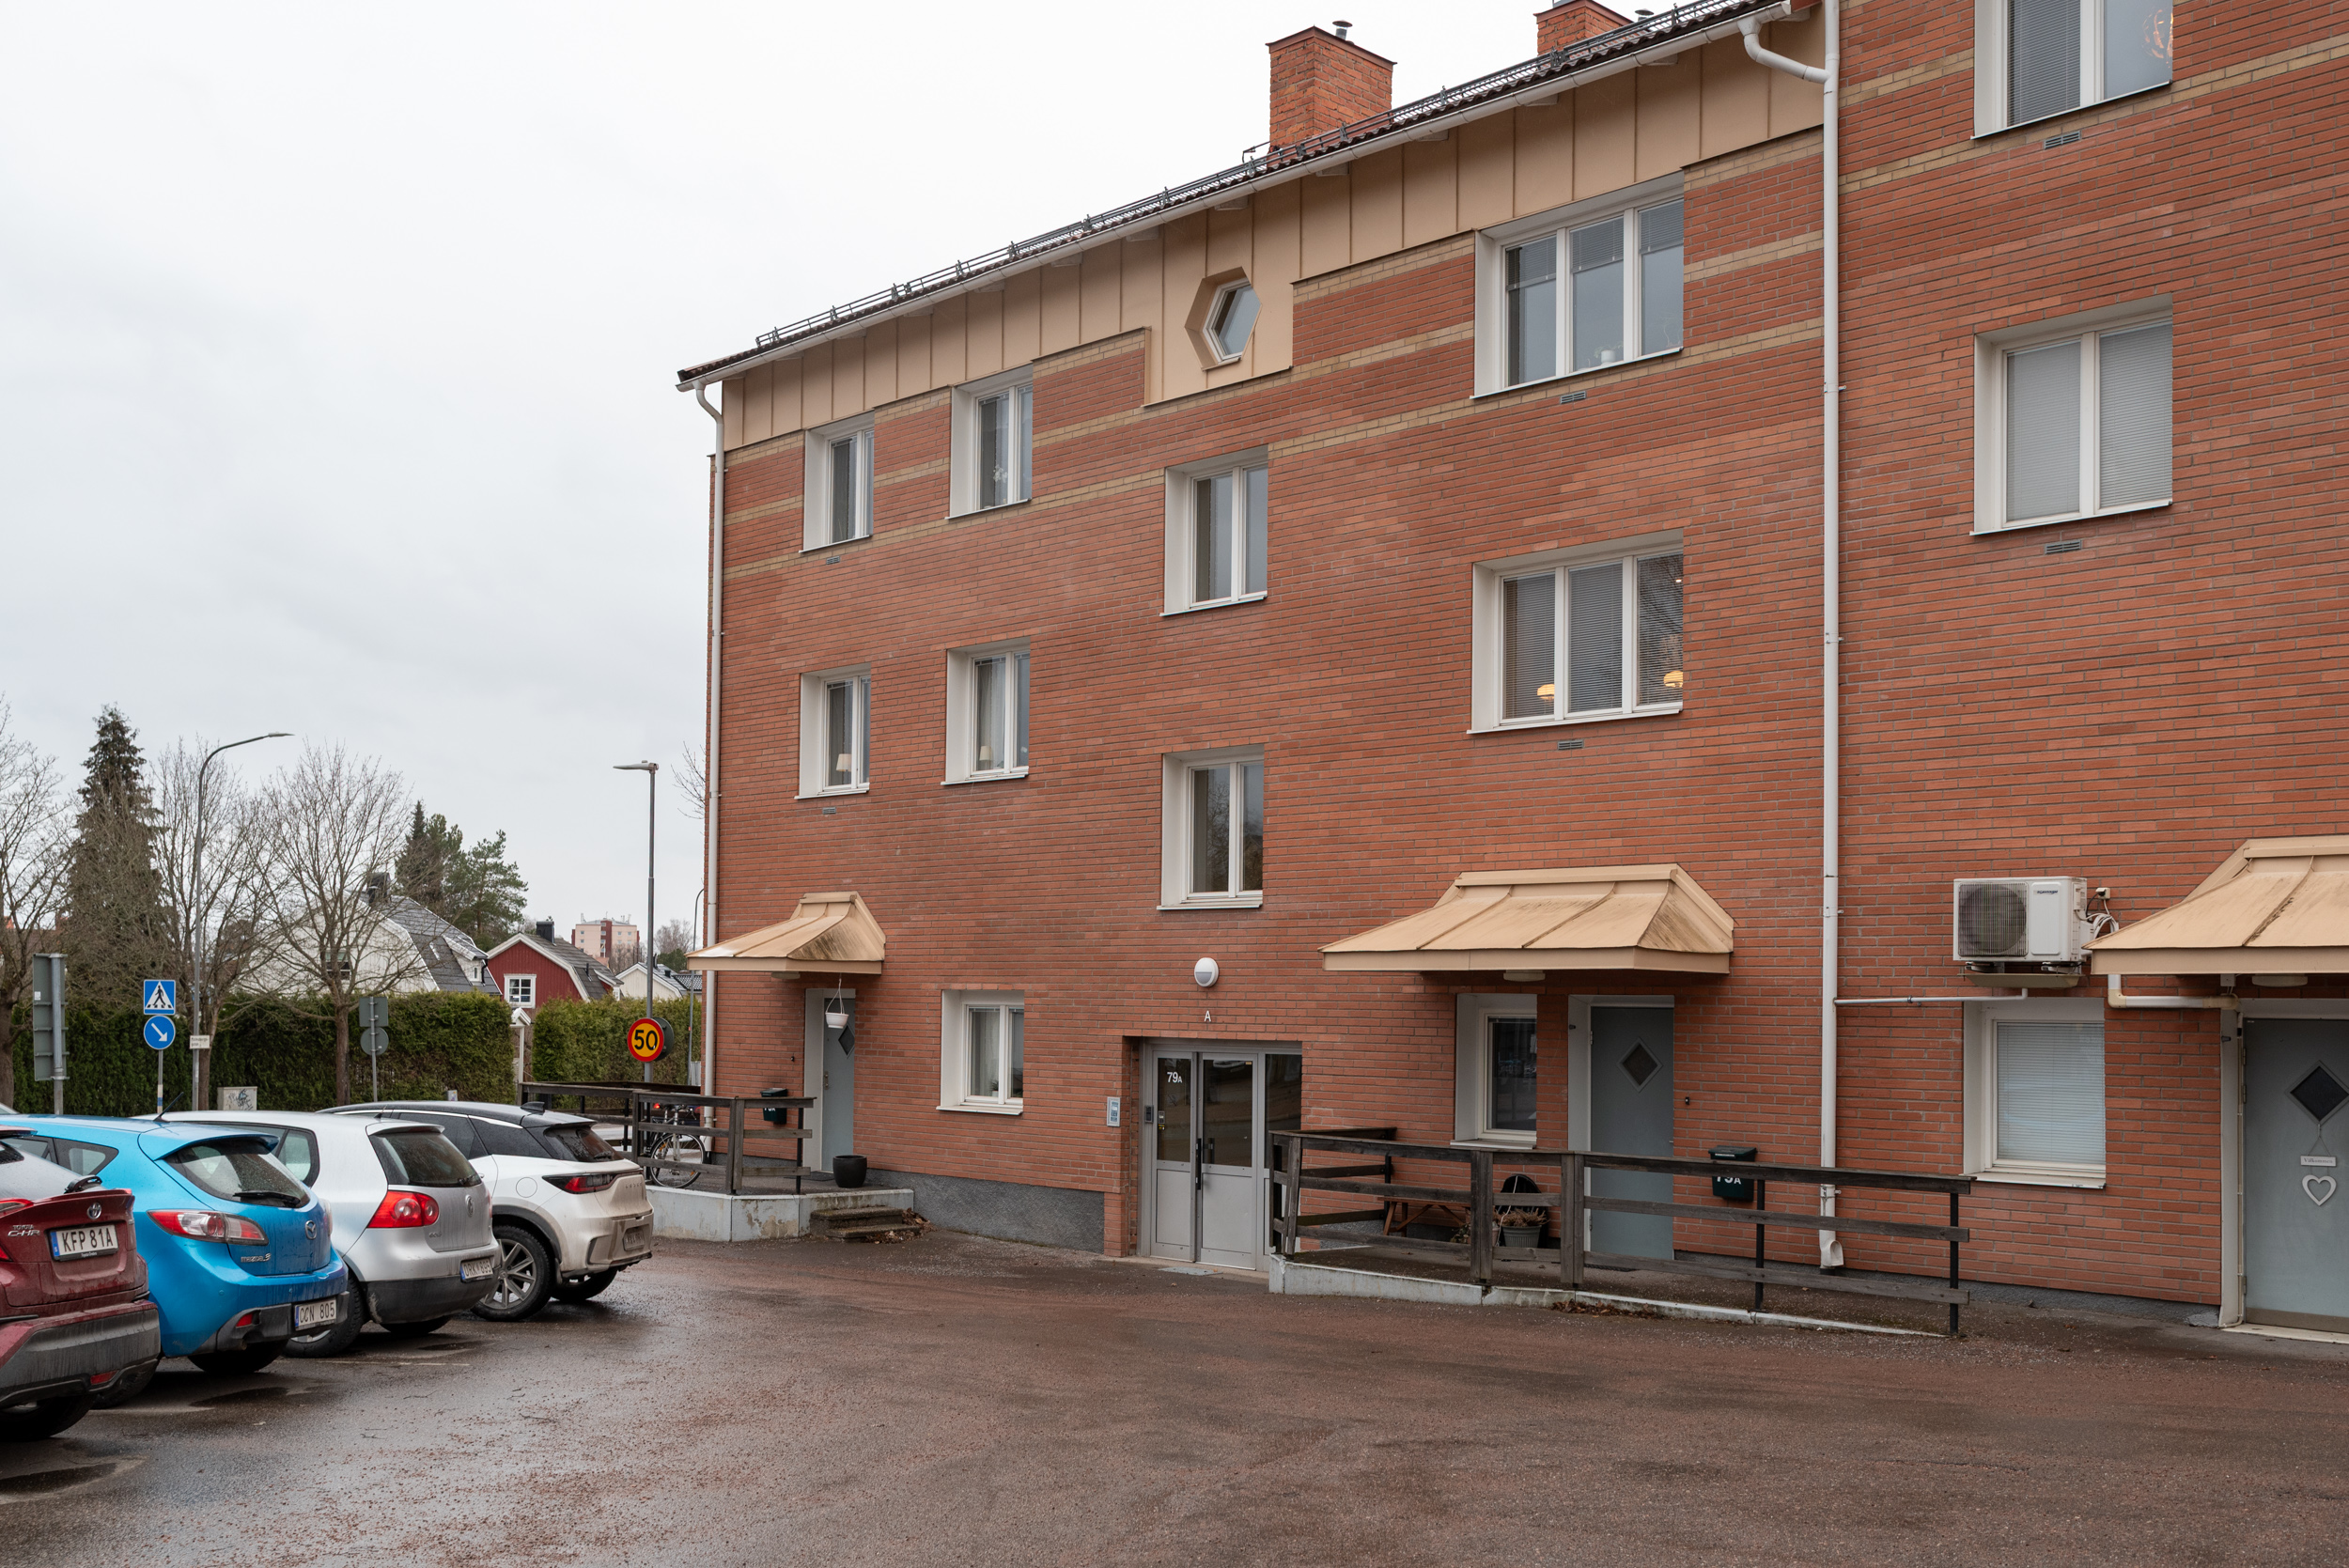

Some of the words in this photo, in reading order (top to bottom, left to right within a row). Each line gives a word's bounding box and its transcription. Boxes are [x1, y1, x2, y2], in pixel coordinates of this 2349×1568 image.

[1204, 1010, 1211, 1022] A
[634, 1030, 658, 1050] 50
[1167, 1071, 1183, 1083] 79A
[62, 1230, 86, 1252] KFP
[89, 1227, 114, 1249] 81A
[300, 1306, 315, 1324] CCN
[319, 1302, 335, 1320] 805
